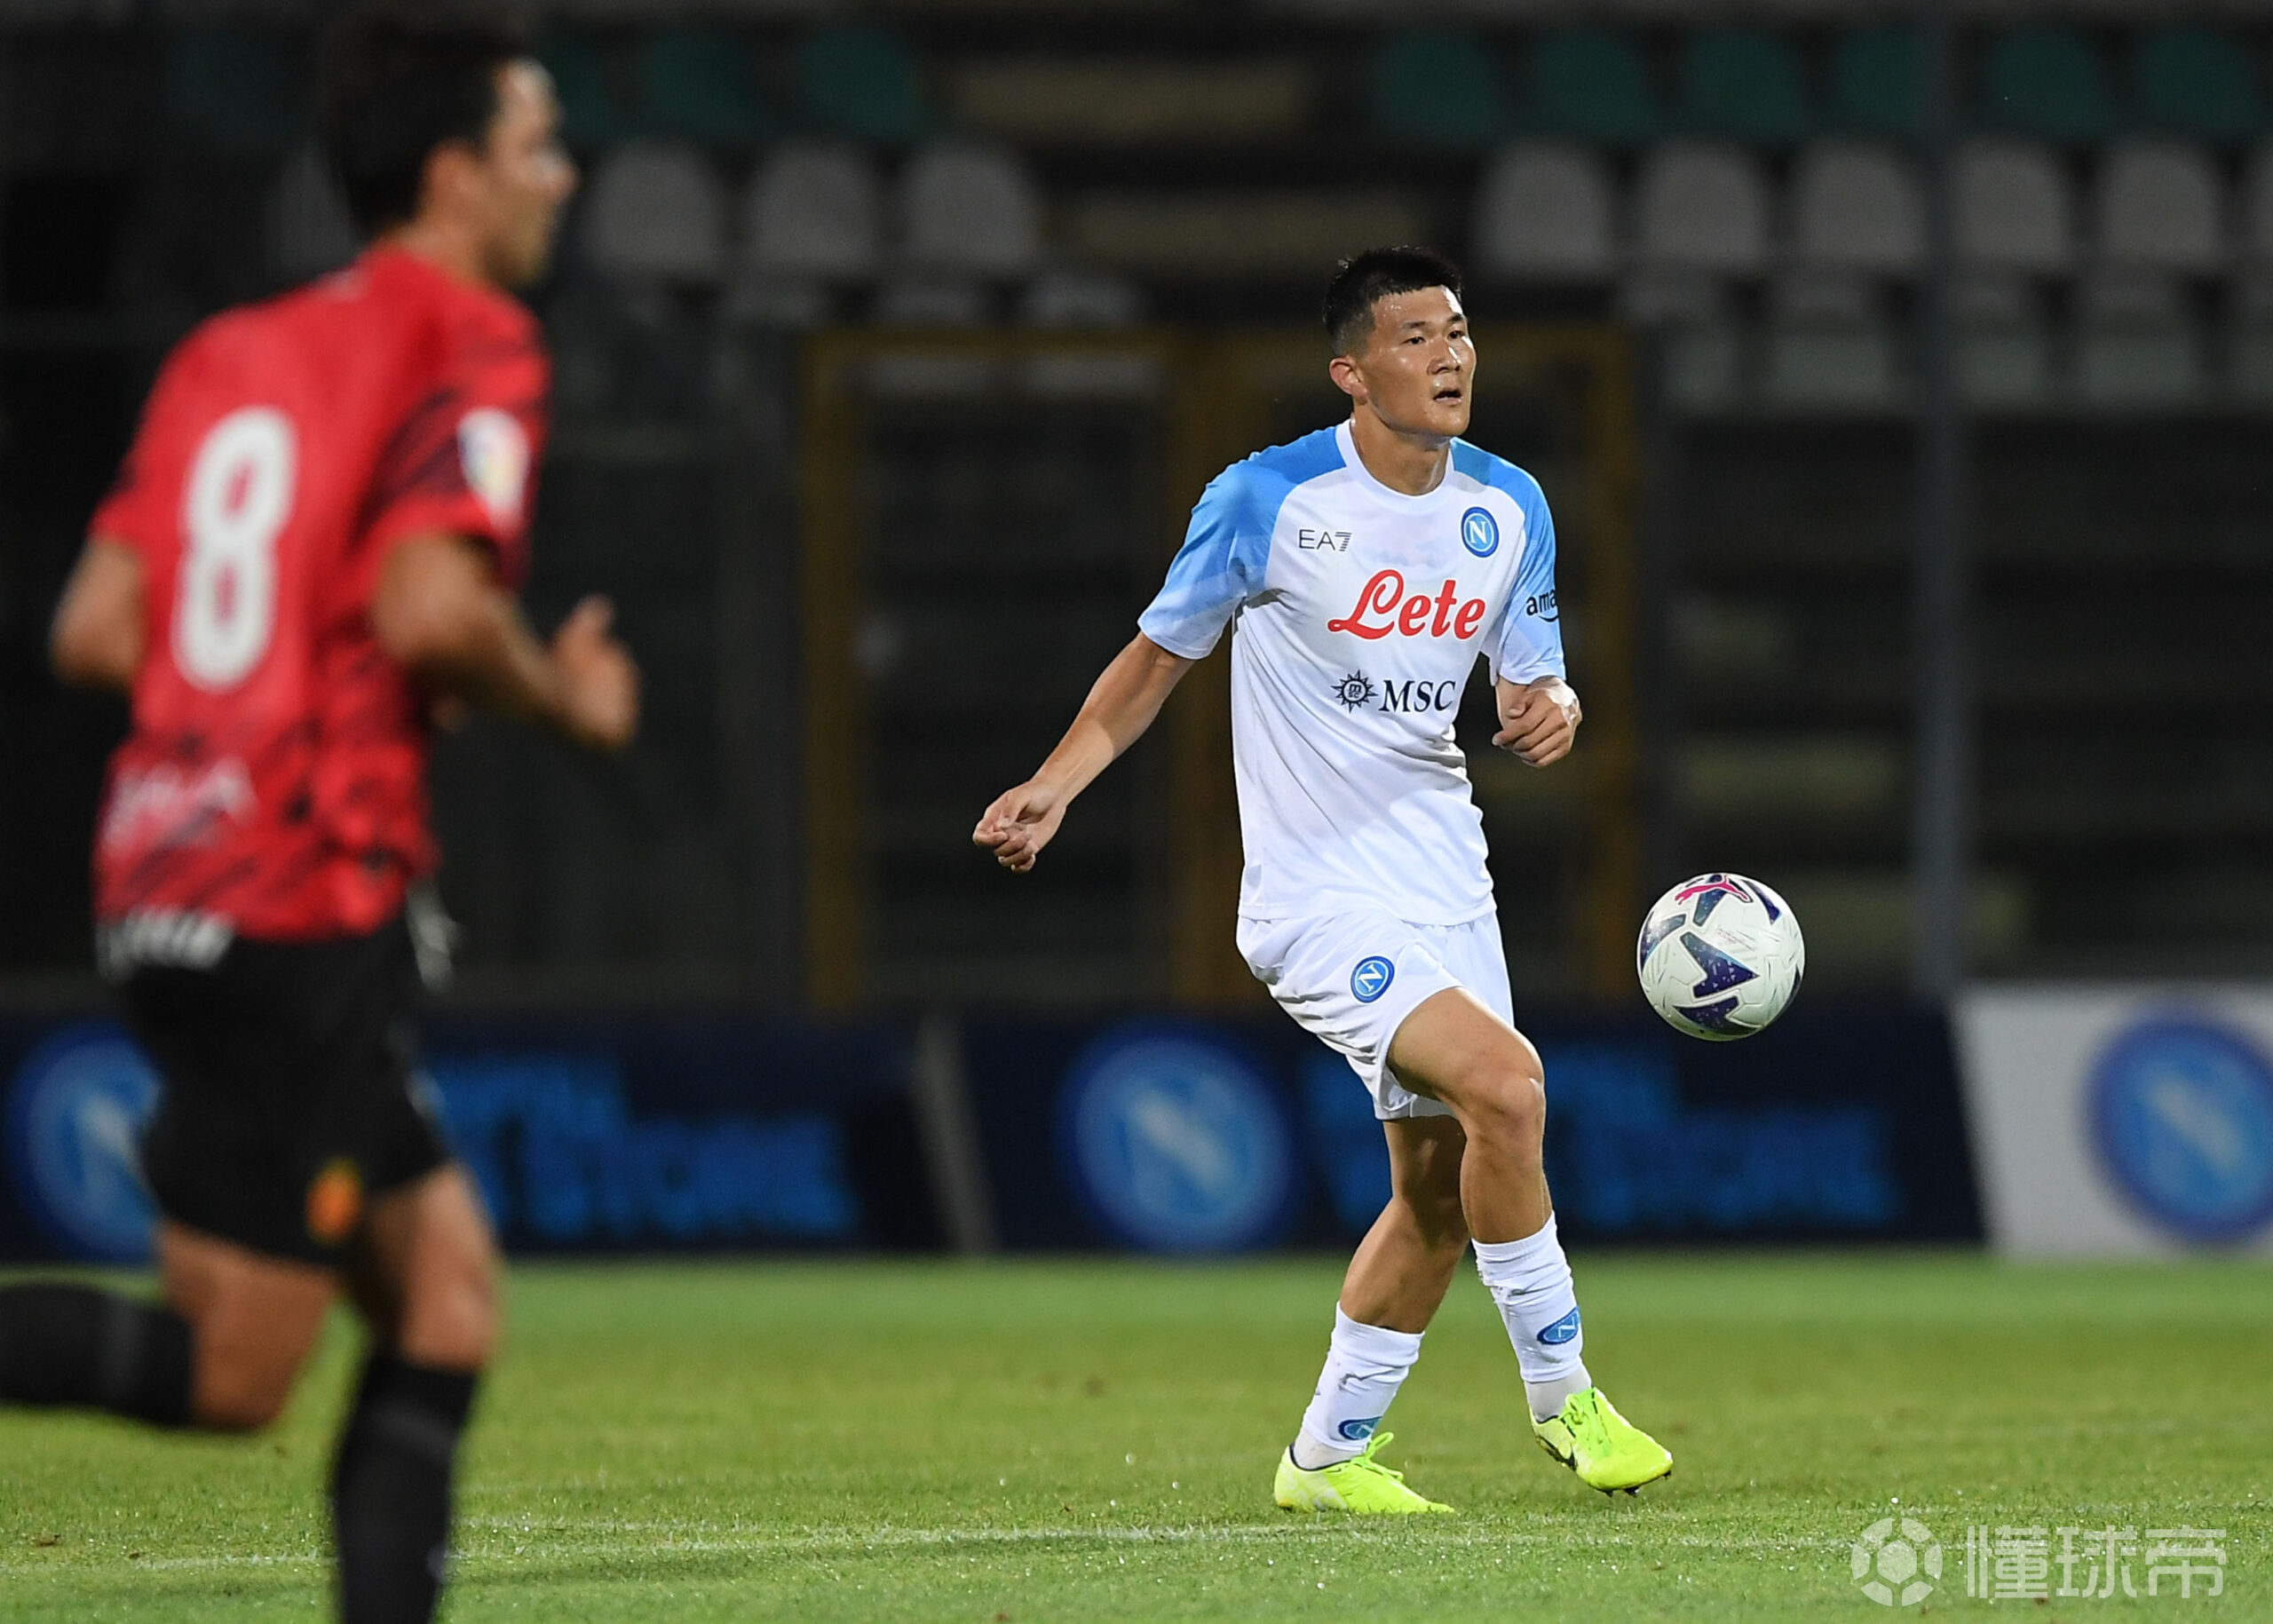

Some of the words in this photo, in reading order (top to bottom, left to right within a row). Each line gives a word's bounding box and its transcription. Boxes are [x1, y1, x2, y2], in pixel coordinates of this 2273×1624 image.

[1299, 529, 1352, 551] EA7
[1469, 520, 1487, 544] N
[171, 405, 297, 693] 8
[1328, 569, 1485, 640] Lete
[1378, 679, 1456, 712] MSC
[1358, 963, 1383, 992] N
